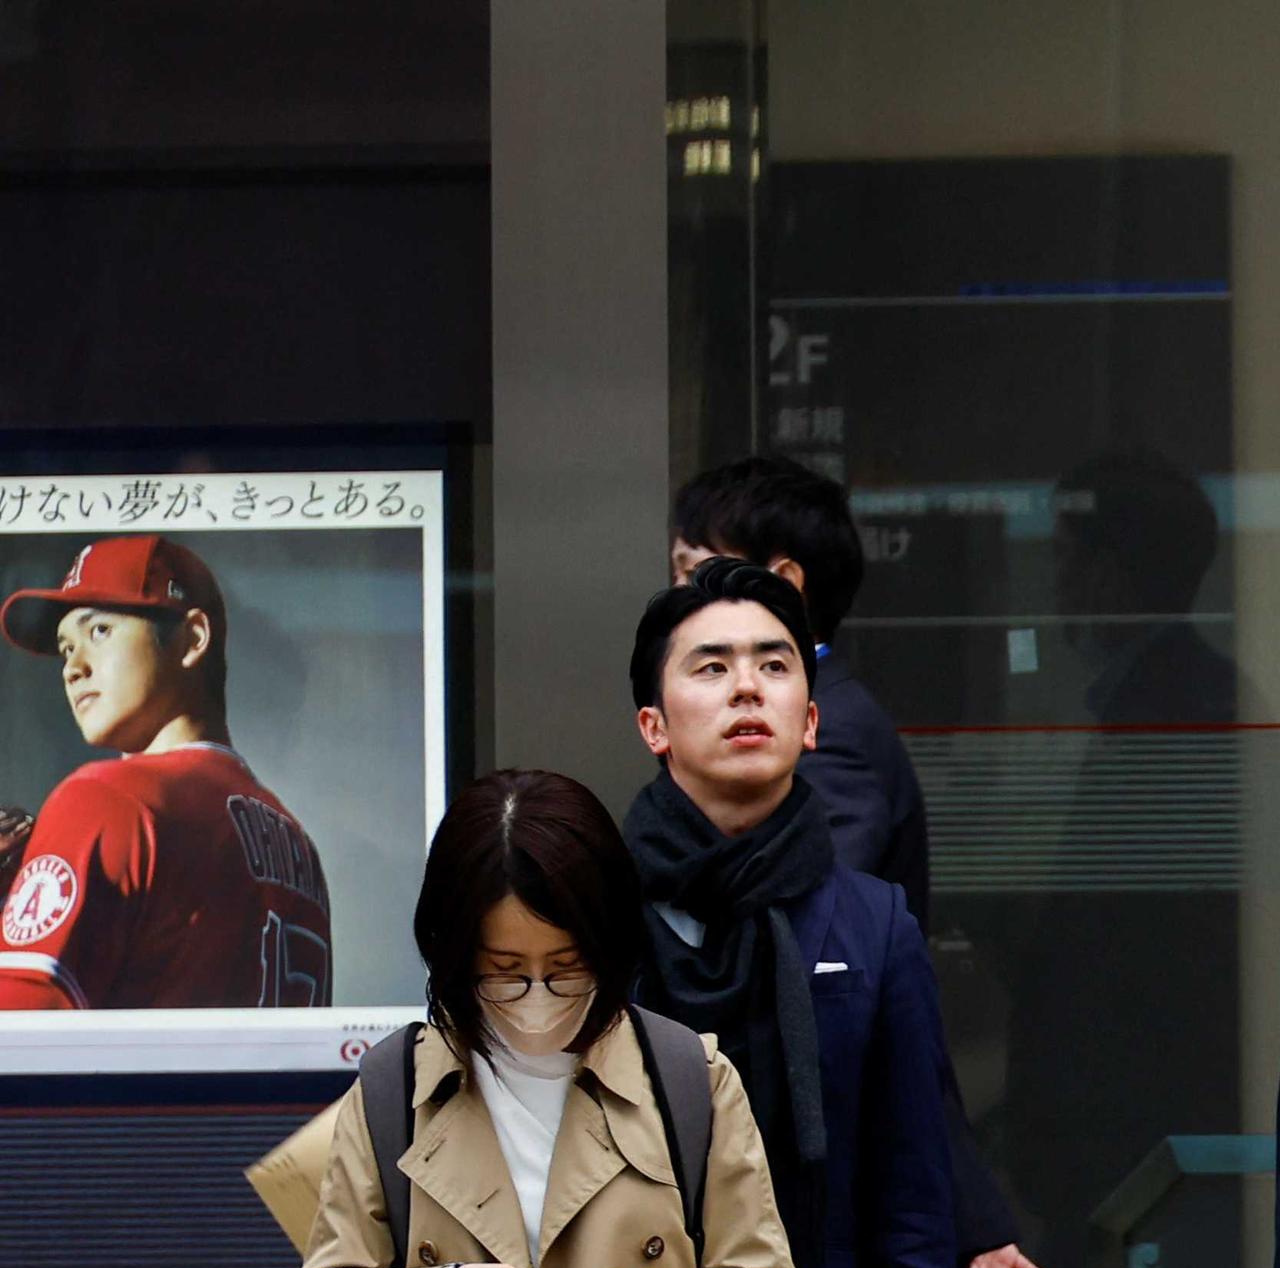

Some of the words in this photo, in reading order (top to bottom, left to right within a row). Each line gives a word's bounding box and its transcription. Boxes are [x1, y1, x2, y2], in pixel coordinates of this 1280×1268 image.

[0, 480, 427, 523] けない夢が、きっとある。
